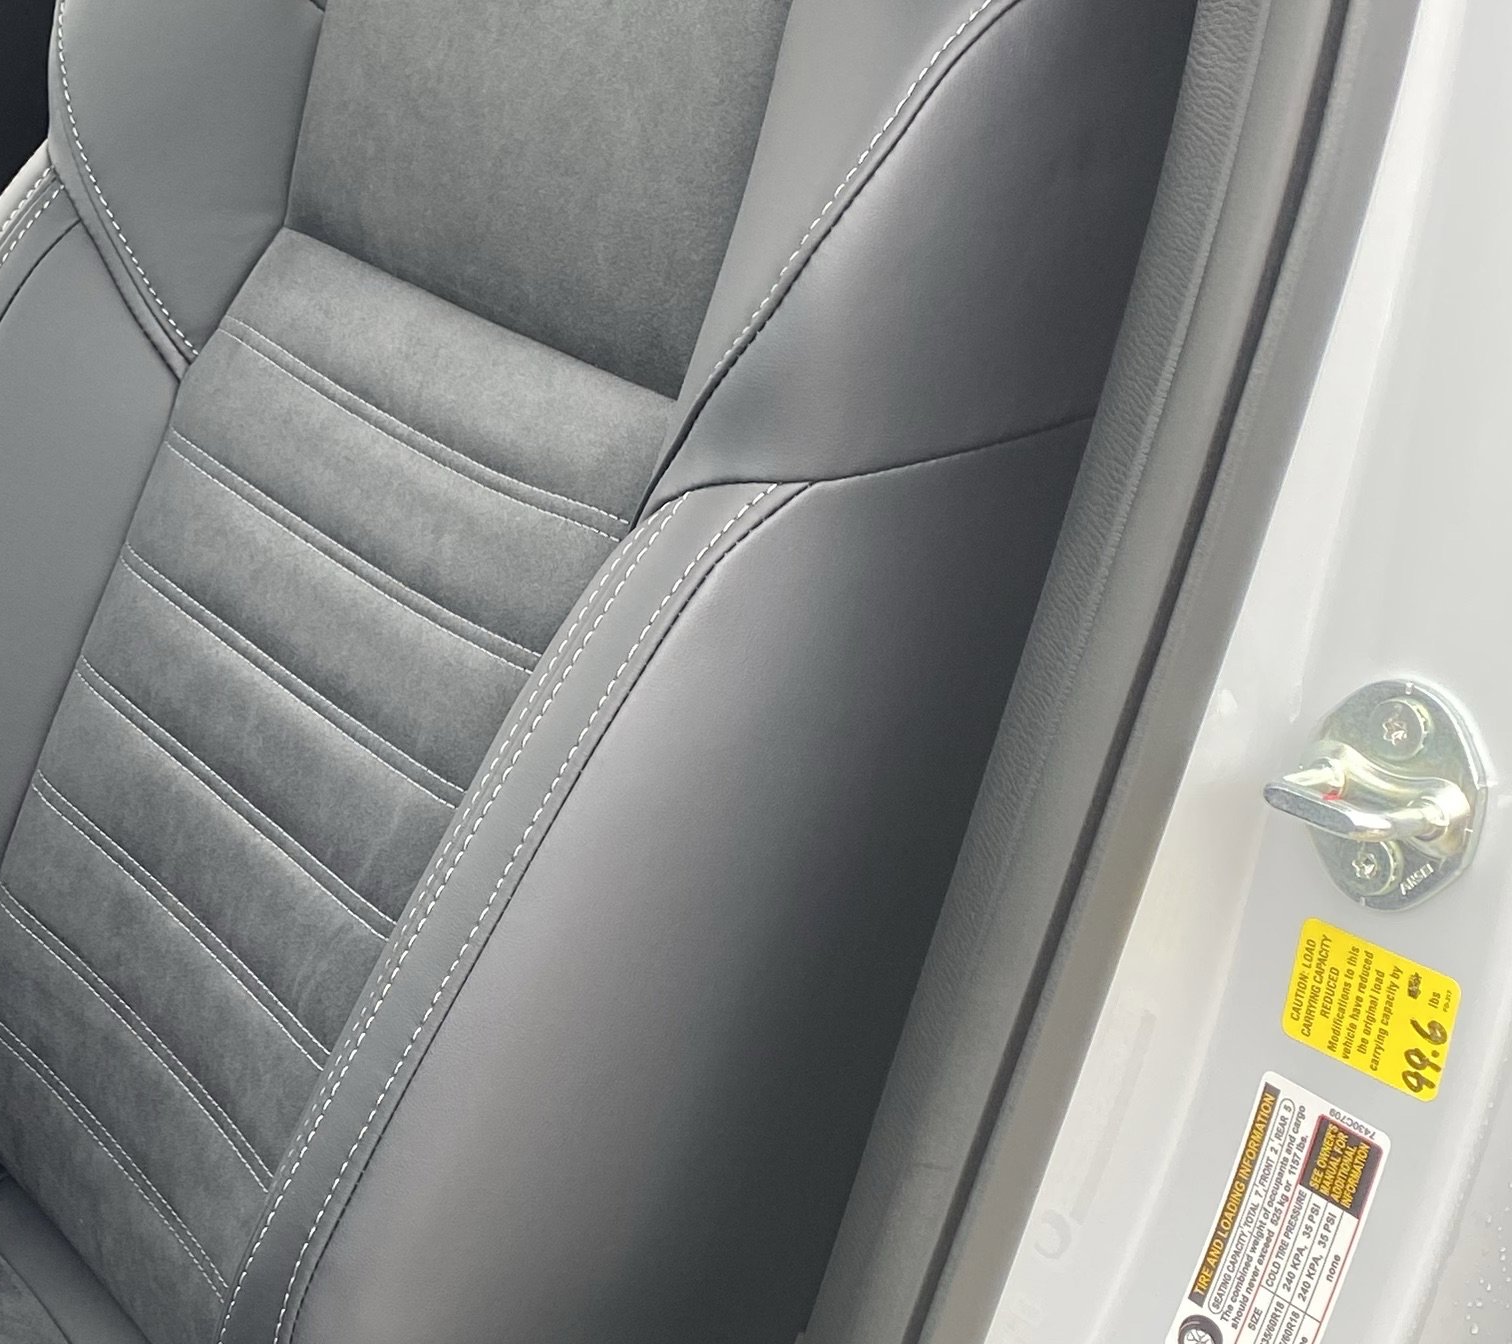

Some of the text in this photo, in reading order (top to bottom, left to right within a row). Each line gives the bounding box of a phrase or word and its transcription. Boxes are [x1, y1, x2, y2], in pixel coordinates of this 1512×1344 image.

[1290, 938, 1317, 1022] CAUTION: LOAD
[1300, 933, 1333, 1038] CARRYING CAPACITY
[1319, 966, 1340, 1020] REDUCED
[1326, 945, 1360, 1053] Modifications to this
[1341, 950, 1374, 1060] vehicle have reduced
[1356, 968, 1386, 1055] the original load
[1369, 965, 1404, 1072] carrying capacity by
[1427, 991, 1441, 1009] lbs
[1309, 1123, 1339, 1190] SEE OWNER'S
[1319, 1132, 1349, 1197] MANUAL FOR
[1329, 1108, 1376, 1140] 7430C709
[1193, 1092, 1279, 1296] TIRE AND LOADING INFORMATION
[1211, 1104, 1292, 1310] SEATING CAPACITY TOTAL 7 FRONT 2 REAR 5
[1219, 1105, 1306, 1322] The combined weight of occupants and cargo
[1330, 1145, 1359, 1203] ADDITIONAL
[1337, 1141, 1371, 1209] INFORMATION
[1231, 1293, 1250, 1330] should
[1245, 1265, 1260, 1295] never
[1256, 1228, 1275, 1266] exceed
[1276, 1193, 1290, 1208] kg
[1283, 1179, 1292, 1193] or
[1288, 1152, 1301, 1176] 1157
[1295, 1135, 1309, 1153] lbs.
[1265, 1189, 1308, 1288] COLD TIRE PRESSURE
[1282, 1202, 1321, 1293] 240 KPA, 35 PSI
[1297, 1212, 1337, 1303] 240 KPA, 35 PSI
[1326, 1254, 1341, 1283] none
[1247, 1306, 1263, 1331] SIZE
